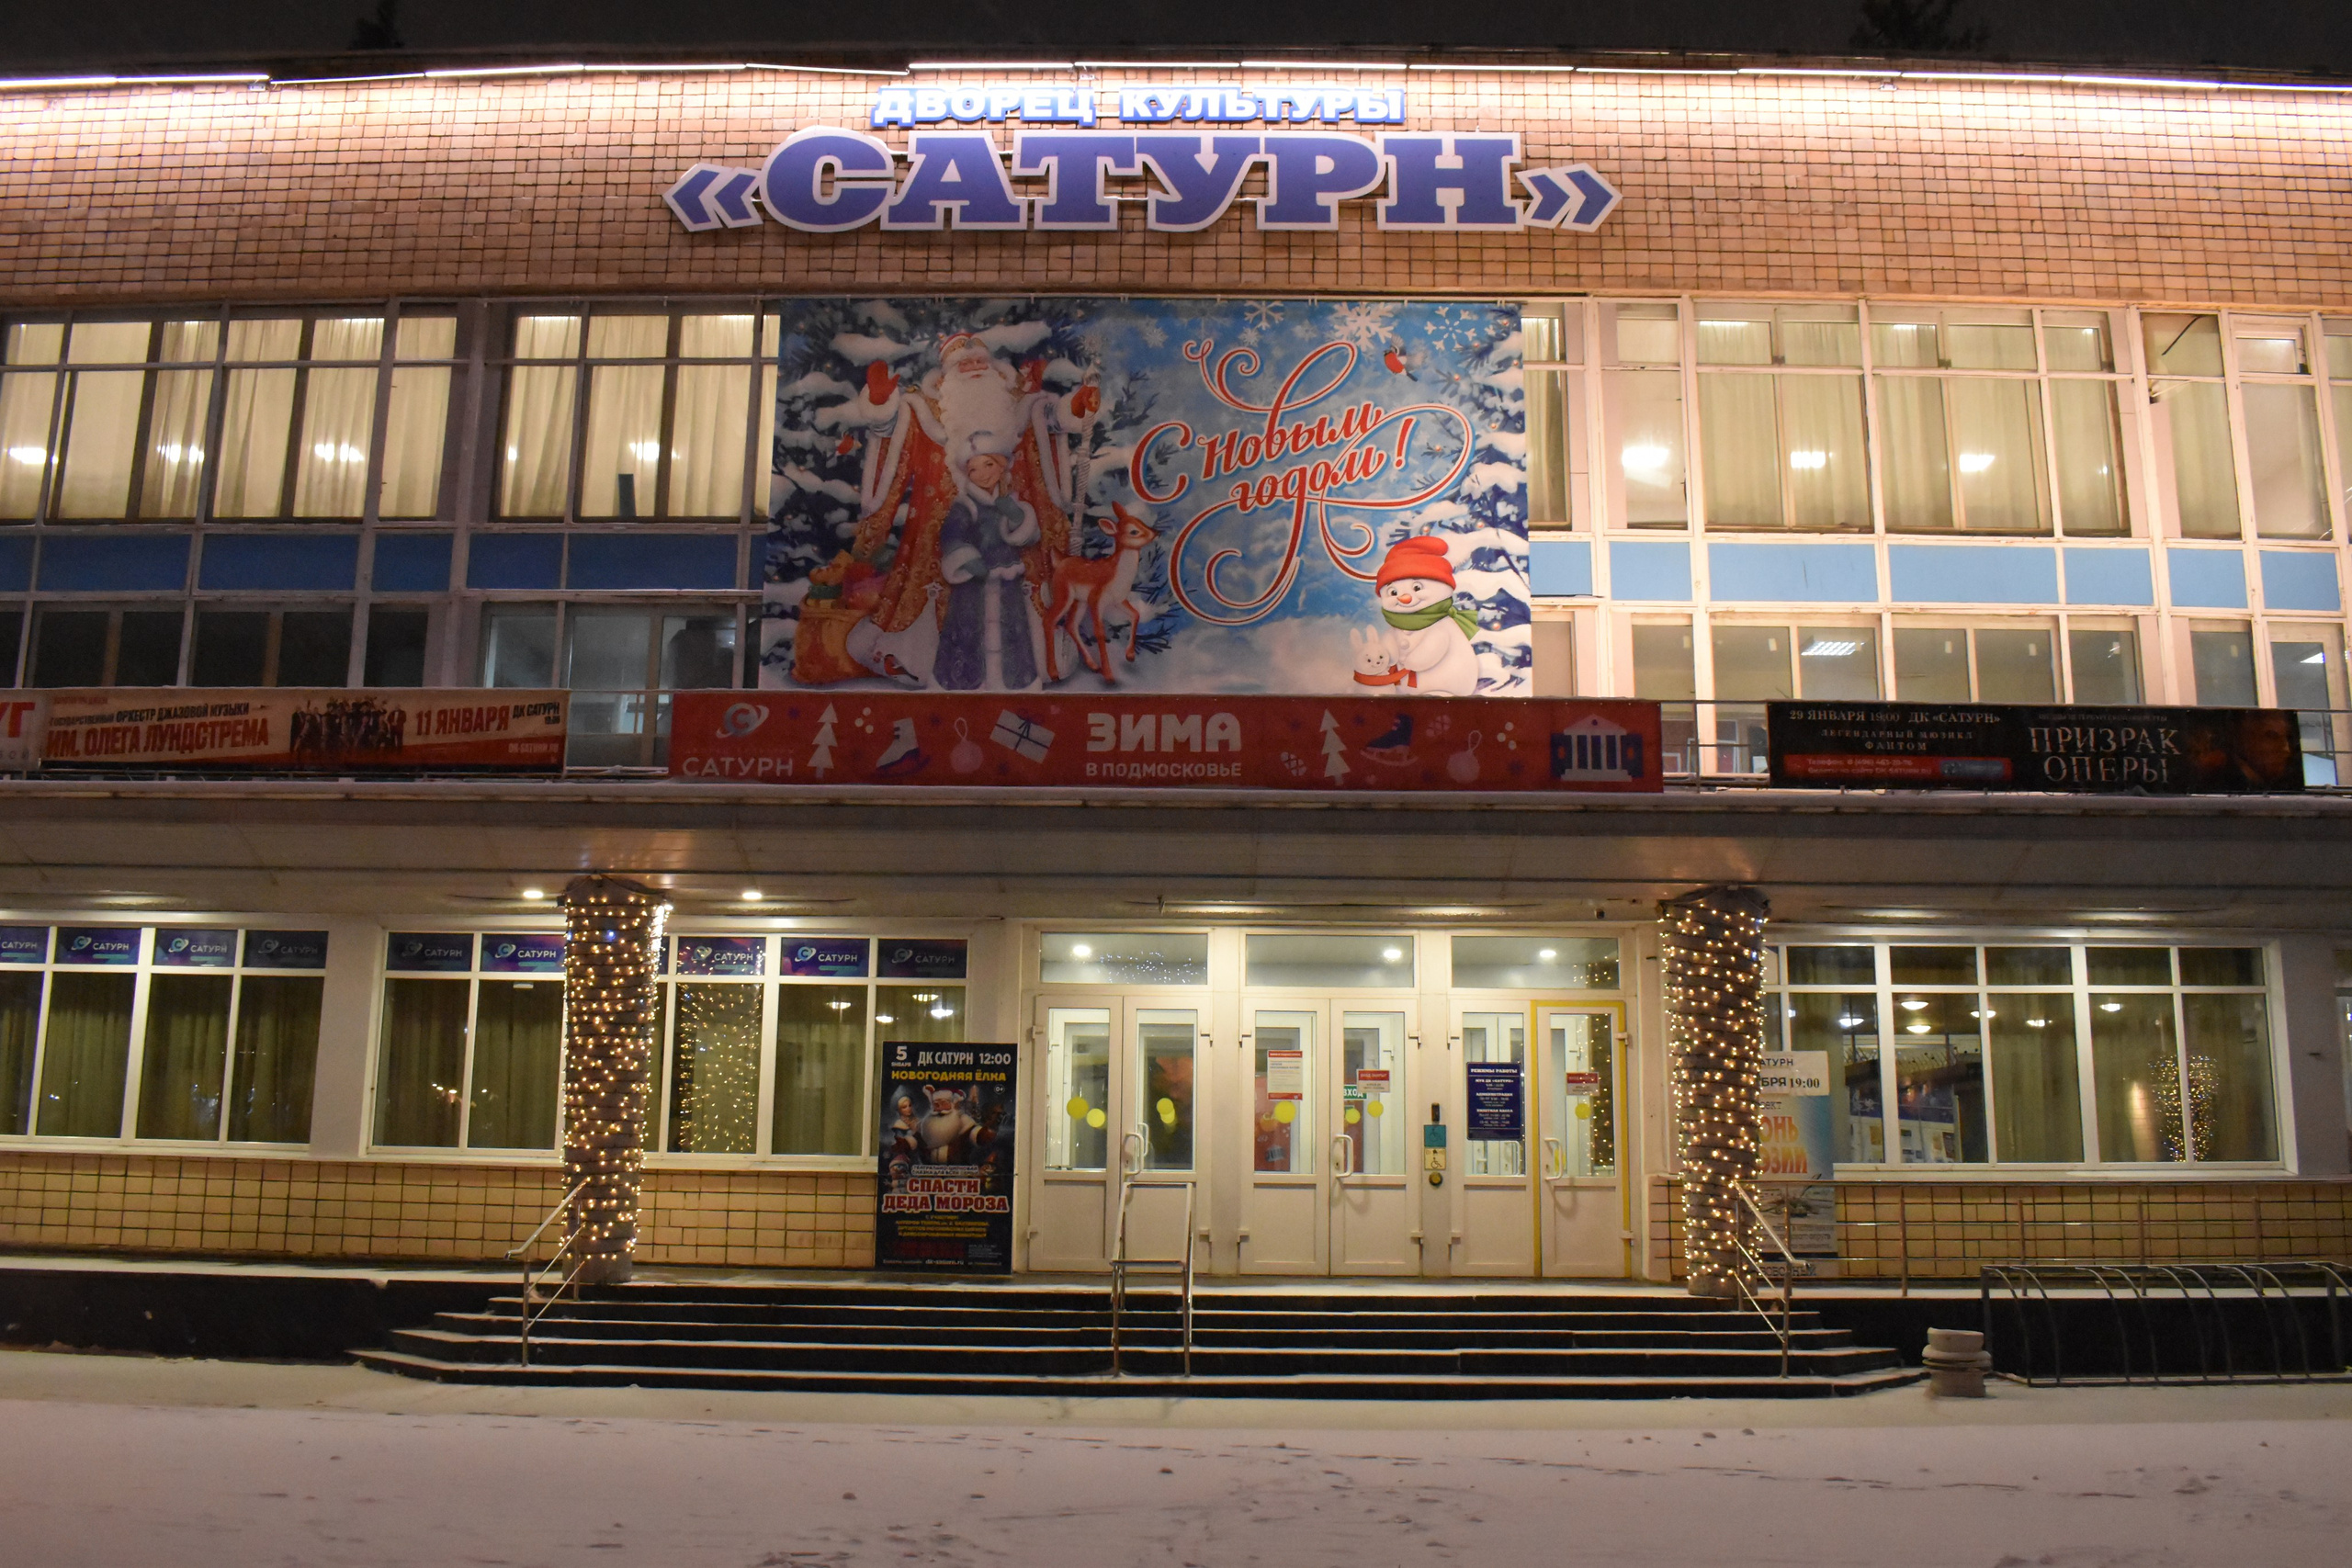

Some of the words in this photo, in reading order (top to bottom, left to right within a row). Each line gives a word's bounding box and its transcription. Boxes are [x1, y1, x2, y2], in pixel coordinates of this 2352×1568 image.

[870, 86, 1096, 128] ДВОРЕЦ
[1119, 86, 1406, 124] КУЛЬТУРЫ
[1130, 422, 1192, 503] С
[116, 710, 157, 723] ОРКЕСТР
[157, 704, 209, 721] ДЖАЗОВОЙ
[210, 703, 250, 717] МУЗЫКИ
[513, 705, 526, 719] ДК
[526, 702, 560, 716] САТУРН
[1790, 710, 1804, 721] 29
[1807, 710, 1865, 721] ЯНВАРЯ
[1870, 712, 1900, 722] 19:00
[1908, 712, 1929, 724] ДК
[1932, 712, 2001, 724] «САТУРН»
[416, 710, 432, 736] 11
[435, 705, 510, 735] ЯНВАРЯ
[47, 729, 80, 757] ИМ.
[85, 725, 141, 756] ОЛЕГА
[143, 717, 269, 754] ЛУНДСТРЕМА
[1087, 712, 1242, 752] ЗИМА
[1820, 728, 1914, 739] ЛЕГЕНДАРНЫЙ
[1919, 730, 1973, 739] МЮЗИКЛ
[1865, 741, 1927, 750] ФАНТОМ
[2028, 727, 2181, 755] ПРИЗРАК
[682, 757, 794, 778] САТУРН
[1086, 762, 1098, 776] В
[1102, 762, 1242, 779] ПОДМОСКОВЬЕ
[2044, 756, 2169, 782] ОПЕРЫ
[1, 941, 38, 950] САТУРН
[93, 942, 130, 952] САТУРН
[190, 944, 228, 953] САТУРН
[424, 949, 463, 958] САТУРН
[518, 950, 557, 959] САТУРН
[714, 953, 754, 962] САТУРН
[818, 953, 858, 963] САТУРН
[896, 1045, 908, 1061] 5
[918, 1051, 933, 1066] ДК
[934, 1052, 974, 1065] САТУРН
[978, 1053, 1012, 1065] 12:00
[1759, 1058, 1793, 1066] АТУРН
[891, 1070, 973, 1081] НОВОГОДНЯЯ
[975, 1069, 1007, 1081] ЁЛКА
[1761, 1077, 1786, 1087] БРЯ
[1790, 1077, 1820, 1089] 19:00
[1758, 1116, 1799, 1143] ОНЬ
[1757, 1146, 1808, 1174] ЭЗИИ
[908, 1178, 980, 1194] СПАСТИ
[882, 1194, 932, 1213] ДЕДА
[934, 1195, 1010, 1213] МОРОЗА
